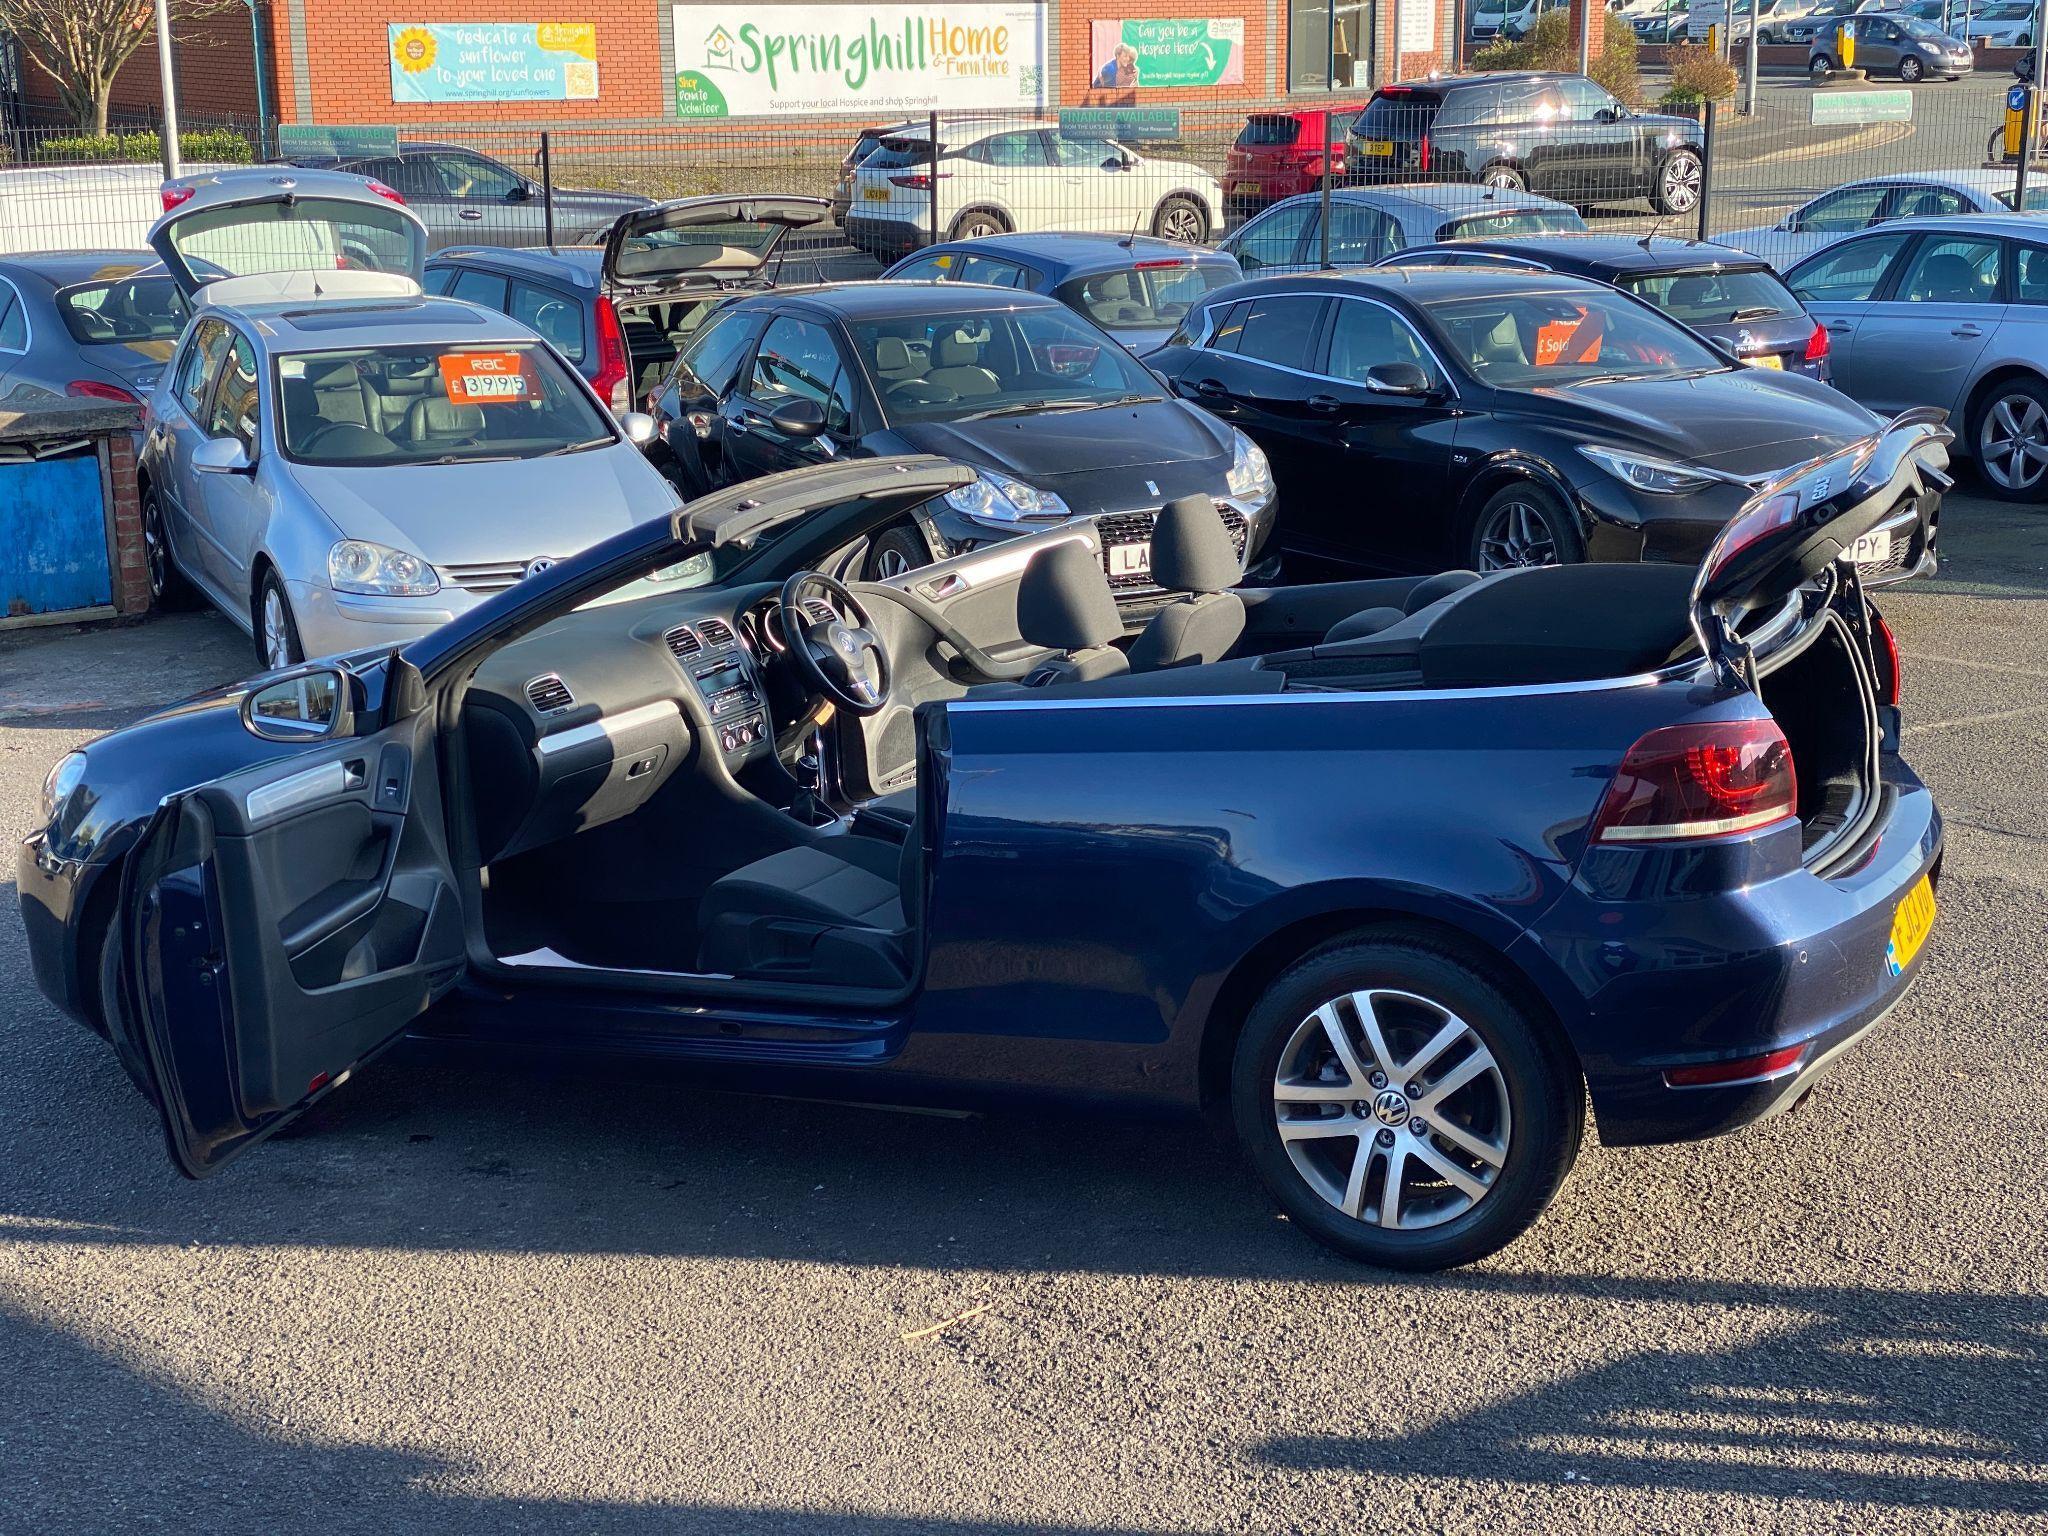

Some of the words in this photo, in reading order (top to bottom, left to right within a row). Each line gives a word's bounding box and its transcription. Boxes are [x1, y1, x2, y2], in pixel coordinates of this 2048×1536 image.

[456, 27, 517, 45] Dedicate
[522, 31, 530, 44] a
[930, 17, 1008, 56] Home
[1138, 24, 1155, 37] Can
[1158, 26, 1175, 42] you
[1177, 22, 1188, 37] be
[459, 46, 526, 63] sunflower
[739, 16, 926, 92] Springhill
[1138, 42, 1170, 60] Hospice
[1173, 40, 1200, 55] Hero?
[933, 53, 945, 67] &
[946, 55, 1008, 76] Furniture
[436, 65, 451, 84] to
[456, 69, 487, 88] your
[491, 64, 528, 82] loved
[533, 68, 556, 81] one
[678, 76, 697, 91] Shop
[445, 88, 550, 98] www.springhill.org/sunflowers
[679, 89, 708, 101] Donate
[679, 102, 720, 114] Volunteer
[769, 99, 800, 110] Support
[802, 100, 819, 109] your
[820, 98, 838, 107] local
[840, 97, 869, 108] Hospice
[869, 97, 884, 106] and
[885, 96, 904, 107] shop
[905, 95, 938, 107] Springhill
[1061, 111, 1112, 122] FINANCE
[1114, 111, 1177, 122] AVAILABLE
[281, 128, 332, 138] FINANCE
[334, 127, 395, 139] AVAILABLE
[1546, 337, 1570, 353] Sold
[452, 380, 461, 394] £
[467, 377, 525, 392] 3995
